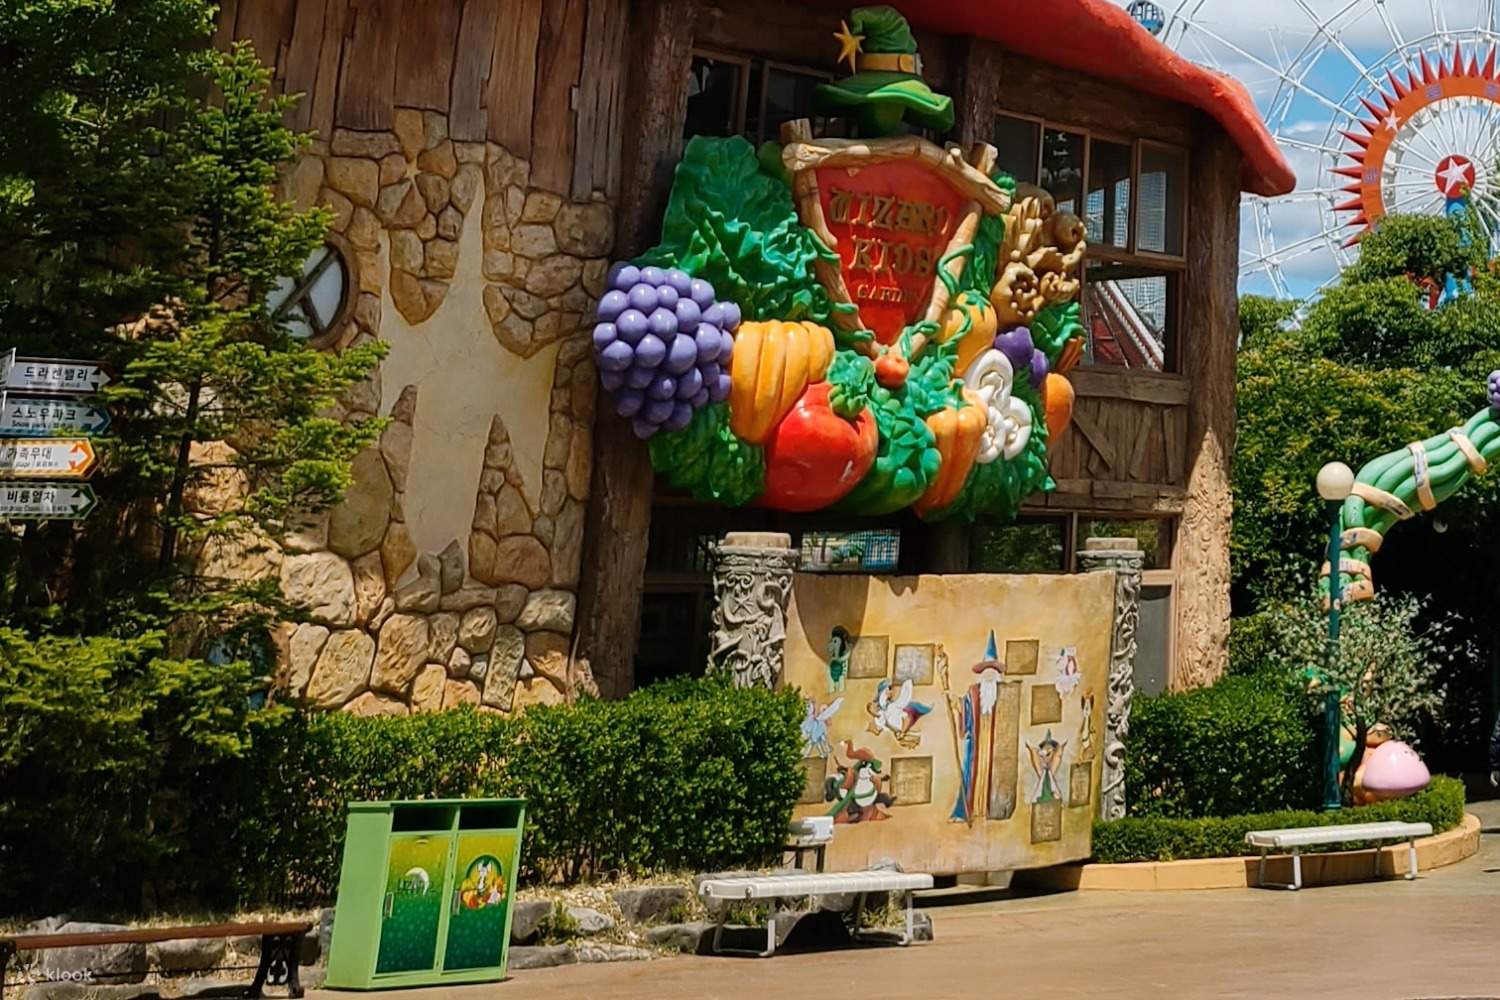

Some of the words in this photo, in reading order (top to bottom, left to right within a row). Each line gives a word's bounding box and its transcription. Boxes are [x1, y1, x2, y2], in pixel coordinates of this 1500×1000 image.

[848, 235, 932, 277] KIDS
[12, 407, 76, 421] 스노우파크
[7, 447, 52, 460] 가족무대
[8, 490, 54, 503] 비룡열차
